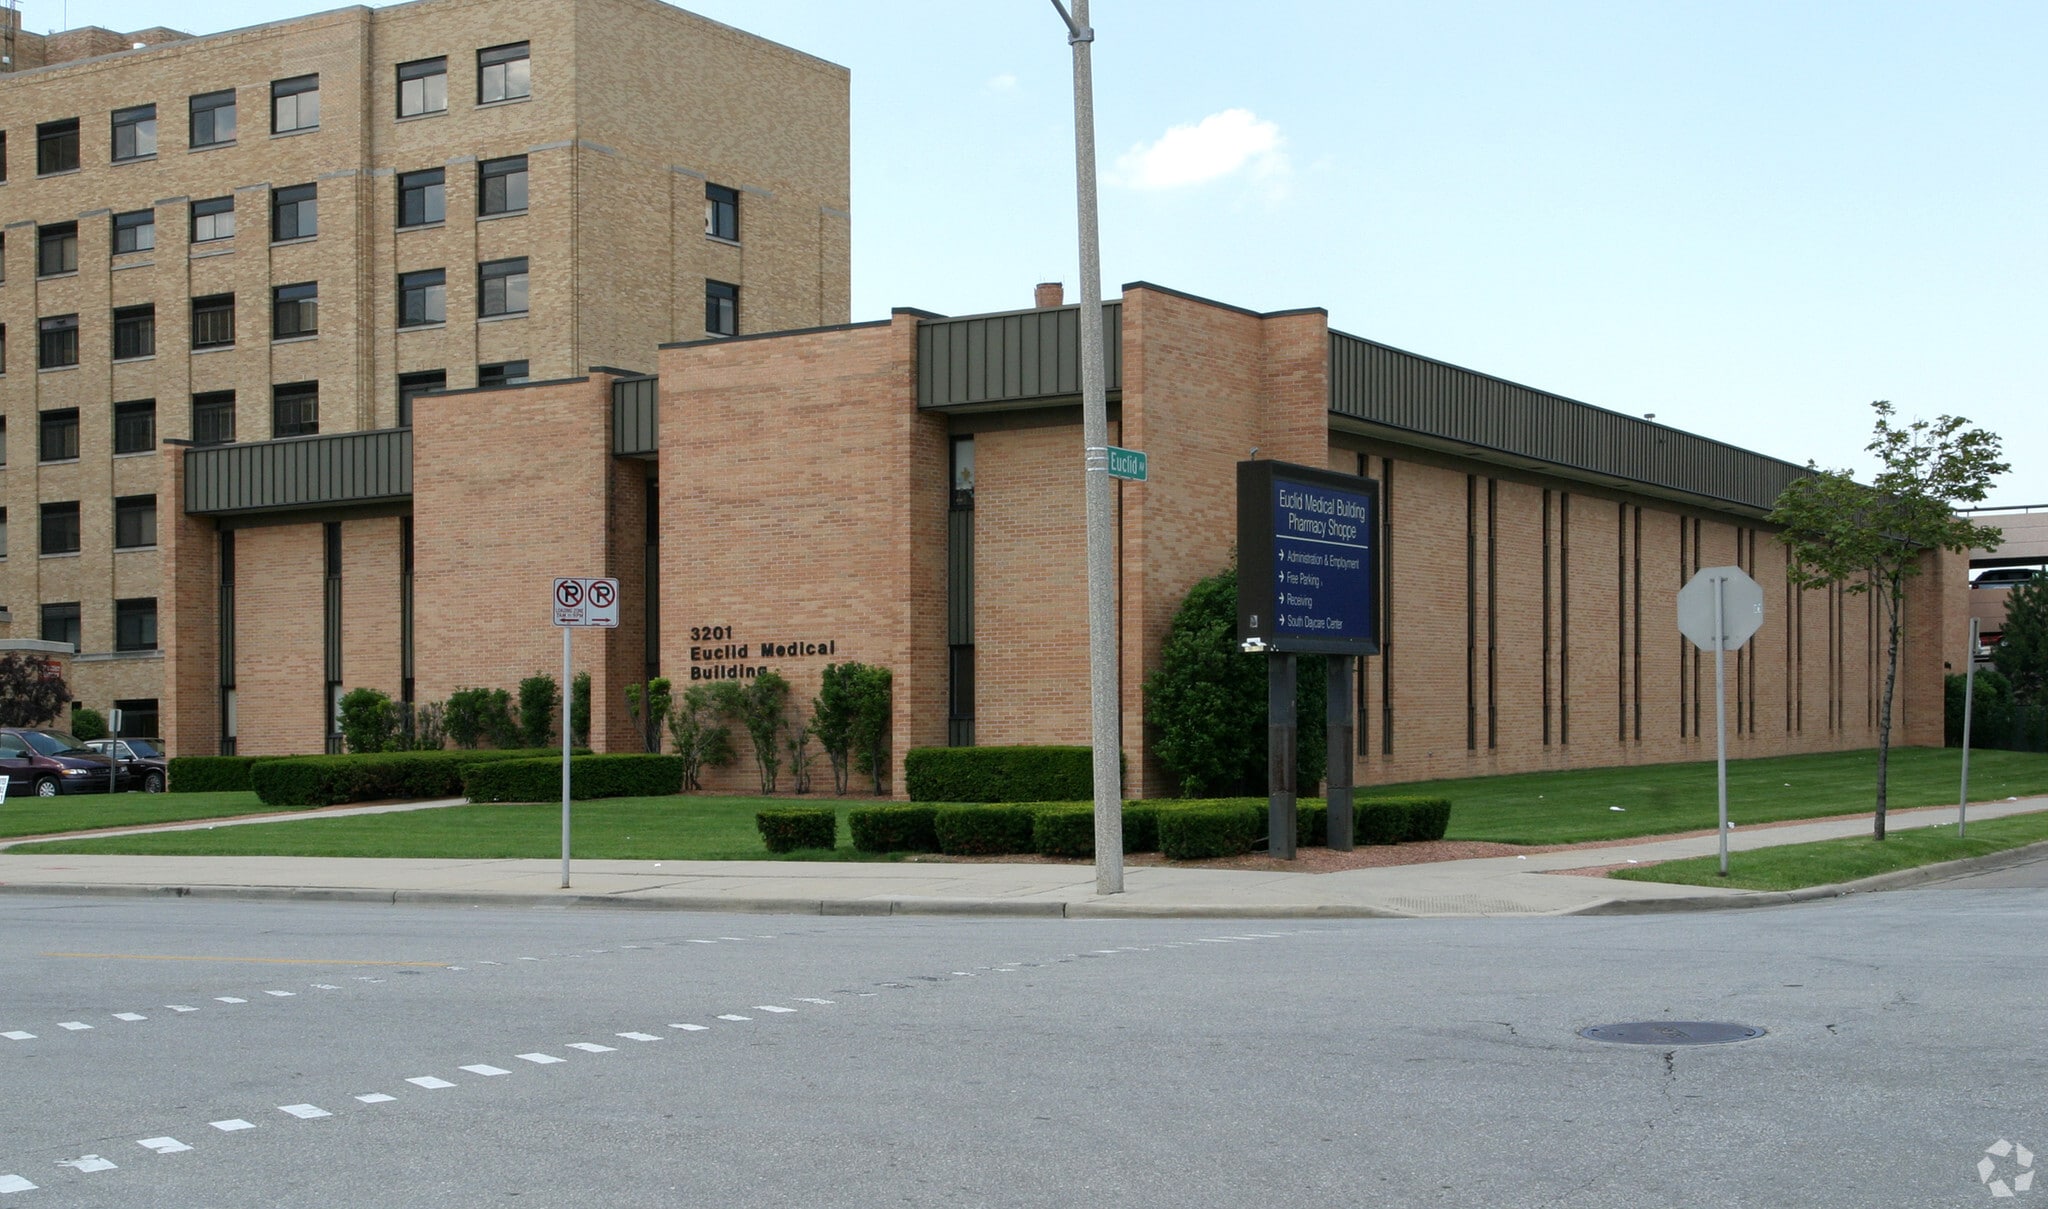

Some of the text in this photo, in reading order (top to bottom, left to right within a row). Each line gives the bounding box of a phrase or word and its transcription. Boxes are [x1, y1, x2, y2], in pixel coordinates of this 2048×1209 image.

[1111, 452, 1137, 474] Euclid
[1280, 489, 1366, 523] Euclid Medical Building
[1288, 512, 1357, 541] Pharmacy Shoppe
[1287, 550, 1360, 571] Administration & Employment
[1287, 571, 1320, 589] Free Parking
[1287, 592, 1313, 610] Receiving
[1287, 614, 1343, 630] South Daycare Center
[690, 625, 732, 641] 3201
[690, 640, 835, 661] Euclid Medical
